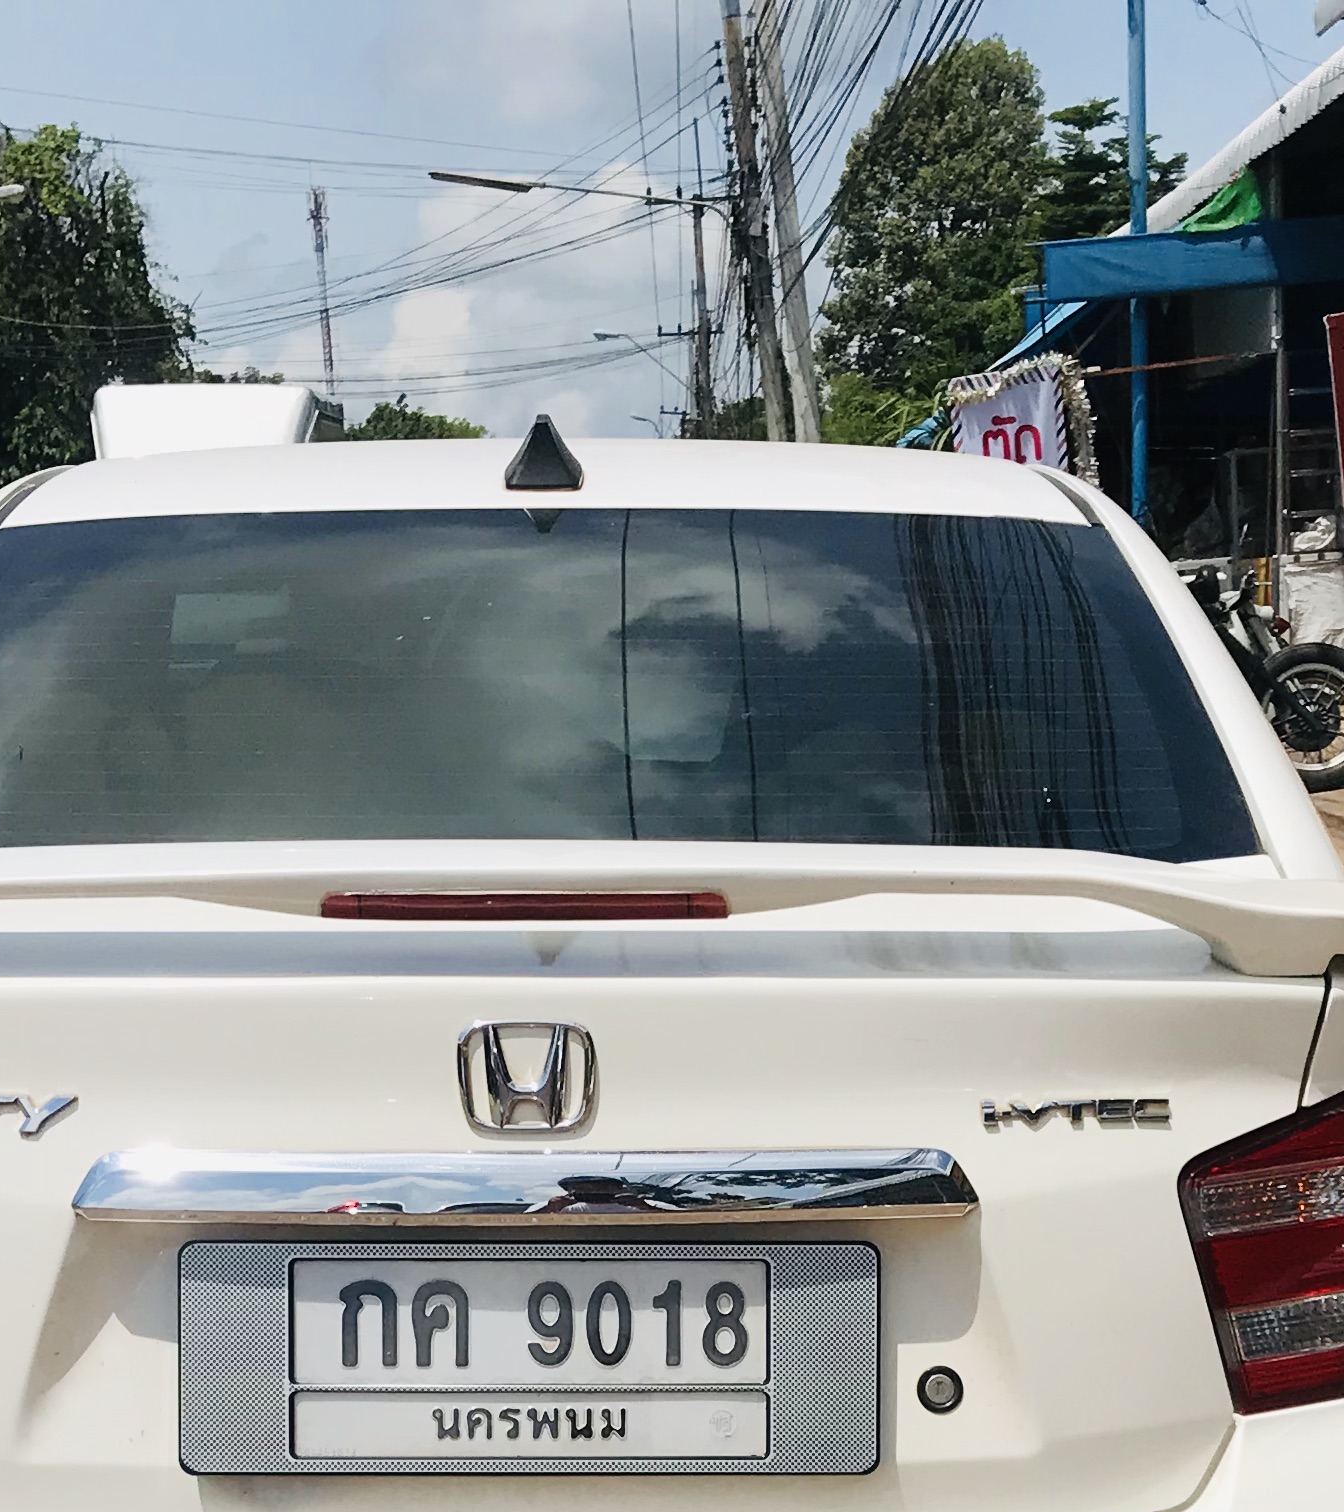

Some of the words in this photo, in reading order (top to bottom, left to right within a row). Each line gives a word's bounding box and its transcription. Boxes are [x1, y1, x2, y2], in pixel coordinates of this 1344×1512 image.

[339, 1278, 470, 1368] กค
[527, 1279, 750, 1368] 9018
[432, 1405, 628, 1440] นครพนม
